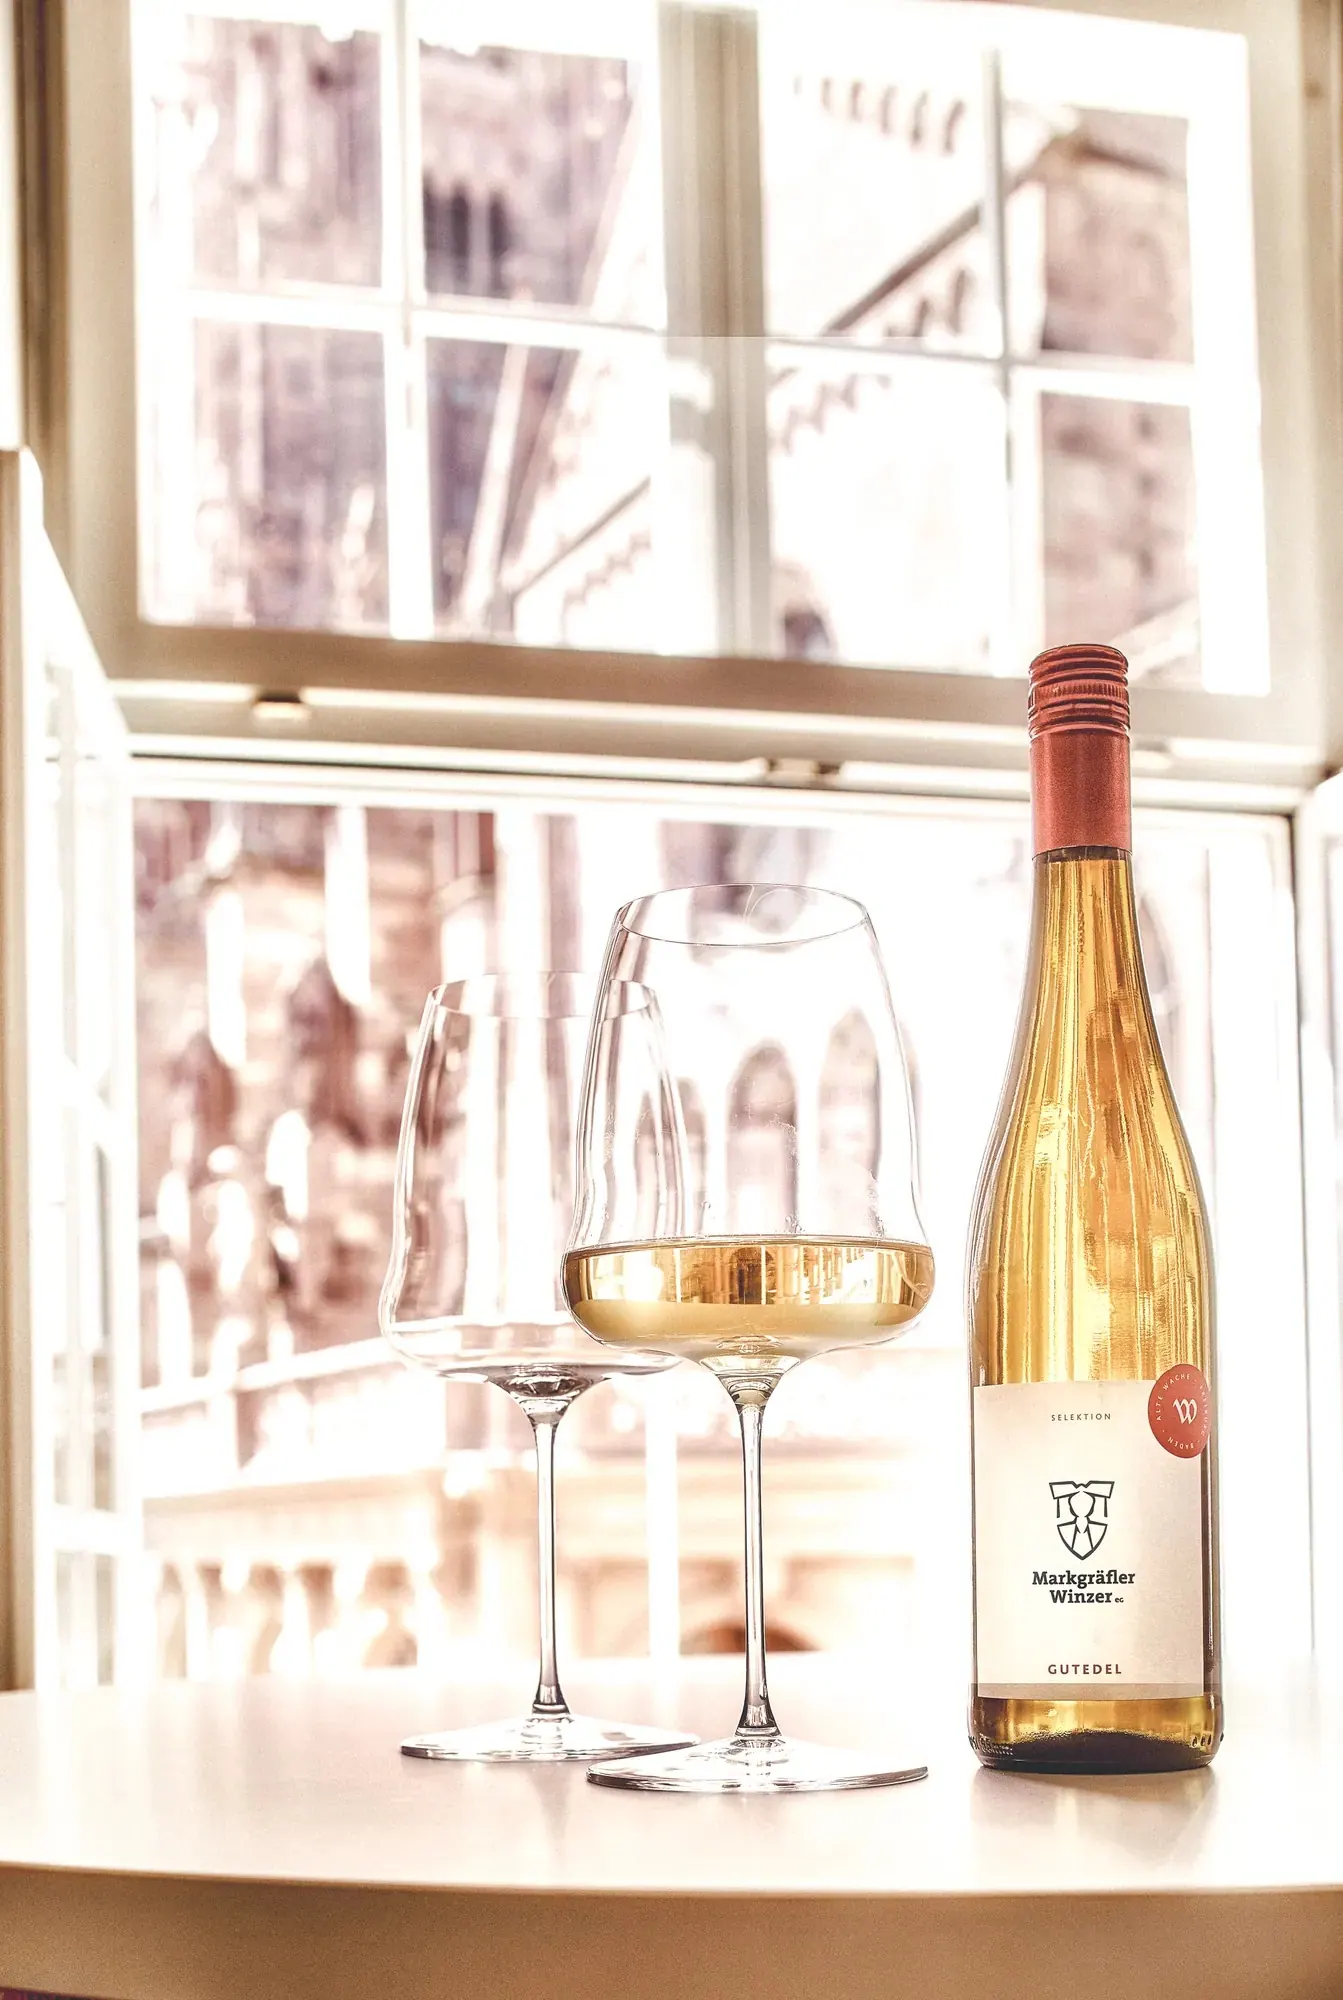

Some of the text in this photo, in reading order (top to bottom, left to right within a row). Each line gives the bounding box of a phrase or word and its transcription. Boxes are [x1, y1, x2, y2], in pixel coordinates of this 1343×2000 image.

[1163, 1374, 1190, 1390] WACHE
[1051, 1413, 1111, 1421] SELEKTION
[1167, 1437, 1194, 1449] BADEN
[1032, 1569, 1136, 1589] Markgräfler
[1049, 1589, 1113, 1603] Winzer
[1047, 1664, 1122, 1675] GUTEDEL
